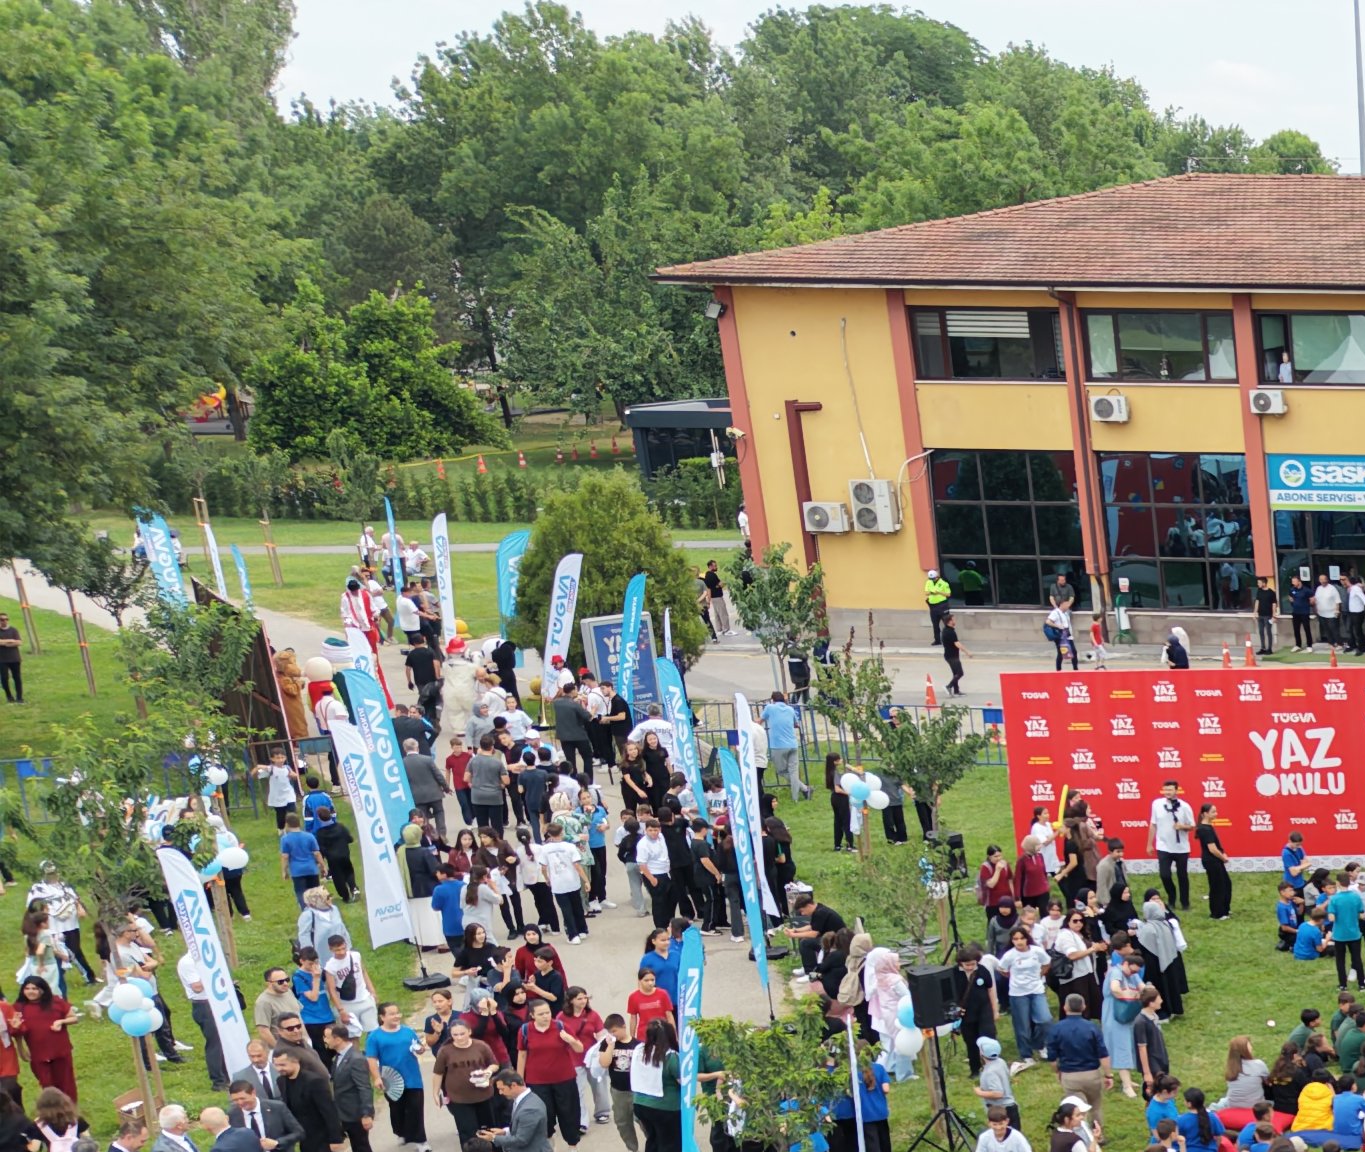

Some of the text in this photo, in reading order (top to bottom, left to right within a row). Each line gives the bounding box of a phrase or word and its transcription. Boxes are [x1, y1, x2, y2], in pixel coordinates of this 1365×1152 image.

[1277, 493, 1313, 502] ABONE
[551, 575, 571, 647] TÜGVA
[1065, 685, 1089, 697] YAZ
[1152, 684, 1175, 696] YAZ
[1237, 683, 1261, 695] YAZ
[1323, 683, 1346, 694] YAZ
[1024, 719, 1047, 731] YAZ
[1110, 718, 1134, 729] YAZ
[1197, 717, 1220, 728] YAZ
[1249, 727, 1342, 770] YAZ
[1071, 752, 1094, 764] YAZ
[1157, 751, 1180, 762] YAZ
[1030, 783, 1053, 795] YAZ
[1116, 781, 1139, 793] YAZ
[1202, 780, 1224, 791] YAZ
[1256, 772, 1345, 797] OKULU
[1249, 814, 1272, 825] YAZ
[1334, 813, 1356, 824] YAZ
